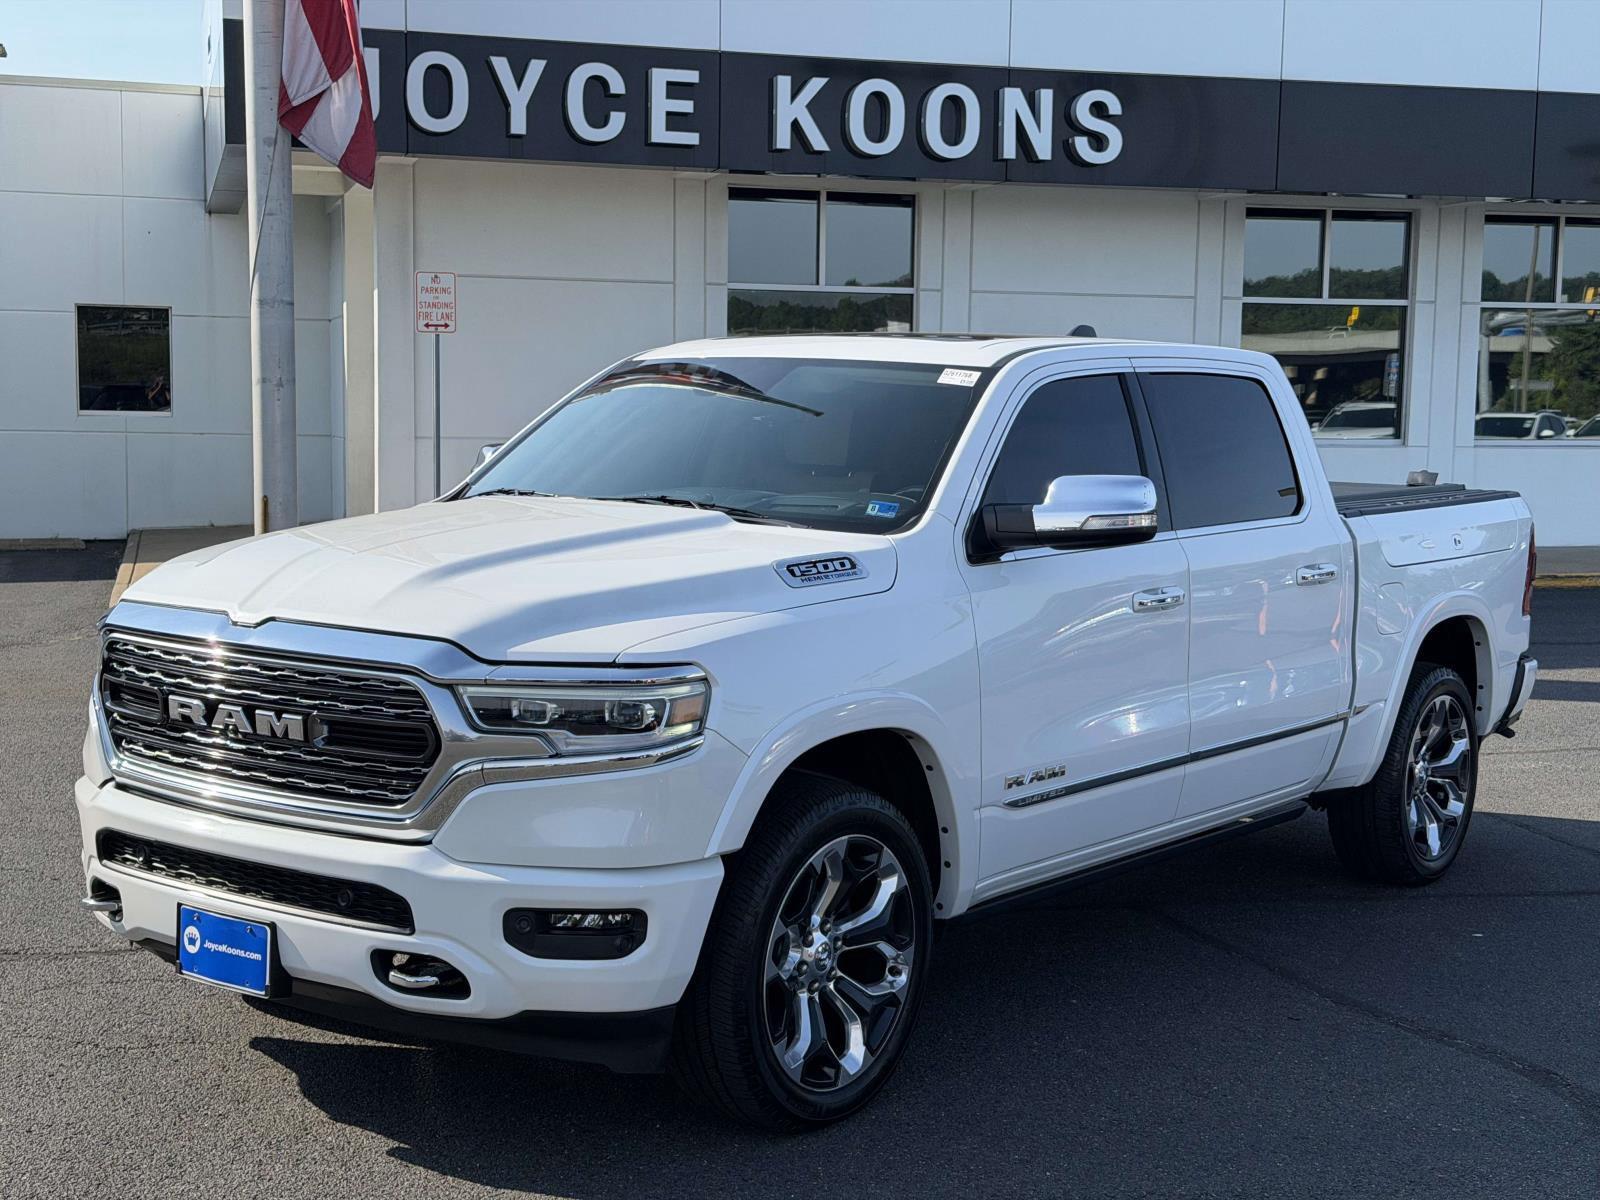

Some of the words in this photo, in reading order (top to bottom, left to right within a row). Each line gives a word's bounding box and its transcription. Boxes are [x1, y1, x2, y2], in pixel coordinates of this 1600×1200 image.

[772, 75, 1123, 165] KOONS
[431, 276, 441, 284] NO
[420, 286, 452, 295] PARKING
[419, 301, 454, 310] STANDING
[418, 311, 433, 321] FIRE
[436, 312, 454, 321] LANE
[788, 559, 853, 577] 1500
[800, 575, 824, 584] HEMI
[168, 695, 304, 741] RAM
[1004, 764, 1066, 790] RAM
[203, 939, 262, 961] JoyceKoons.com
